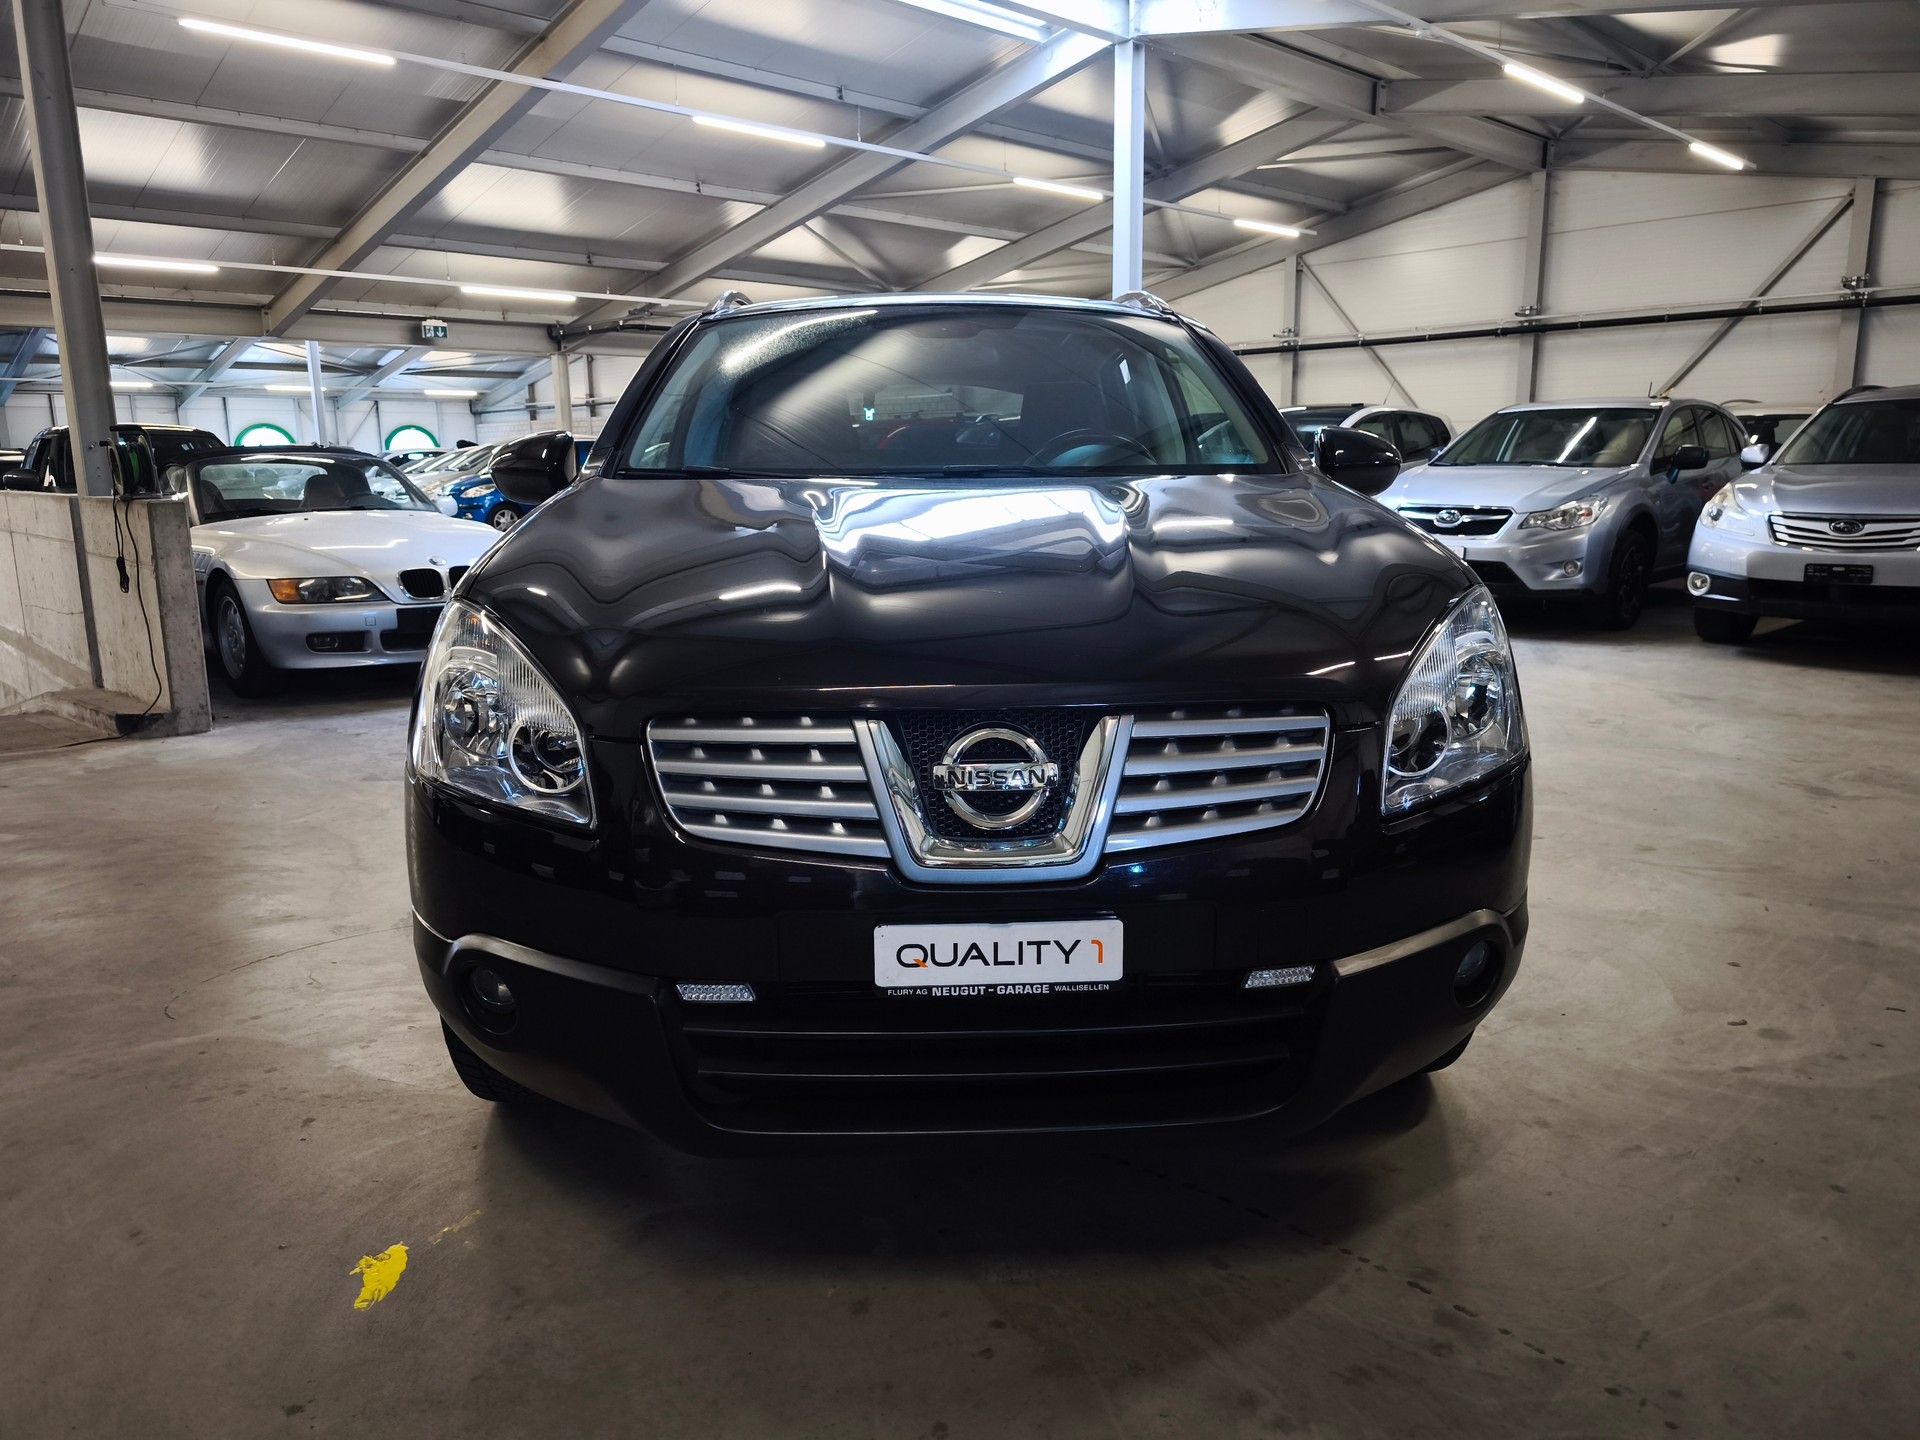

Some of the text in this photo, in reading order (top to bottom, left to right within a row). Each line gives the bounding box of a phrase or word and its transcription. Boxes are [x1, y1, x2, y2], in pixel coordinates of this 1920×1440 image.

[947, 769, 1045, 785] NISSAN
[887, 988, 914, 996] FLURY
[1054, 983, 1110, 992] WALLISELLEN
